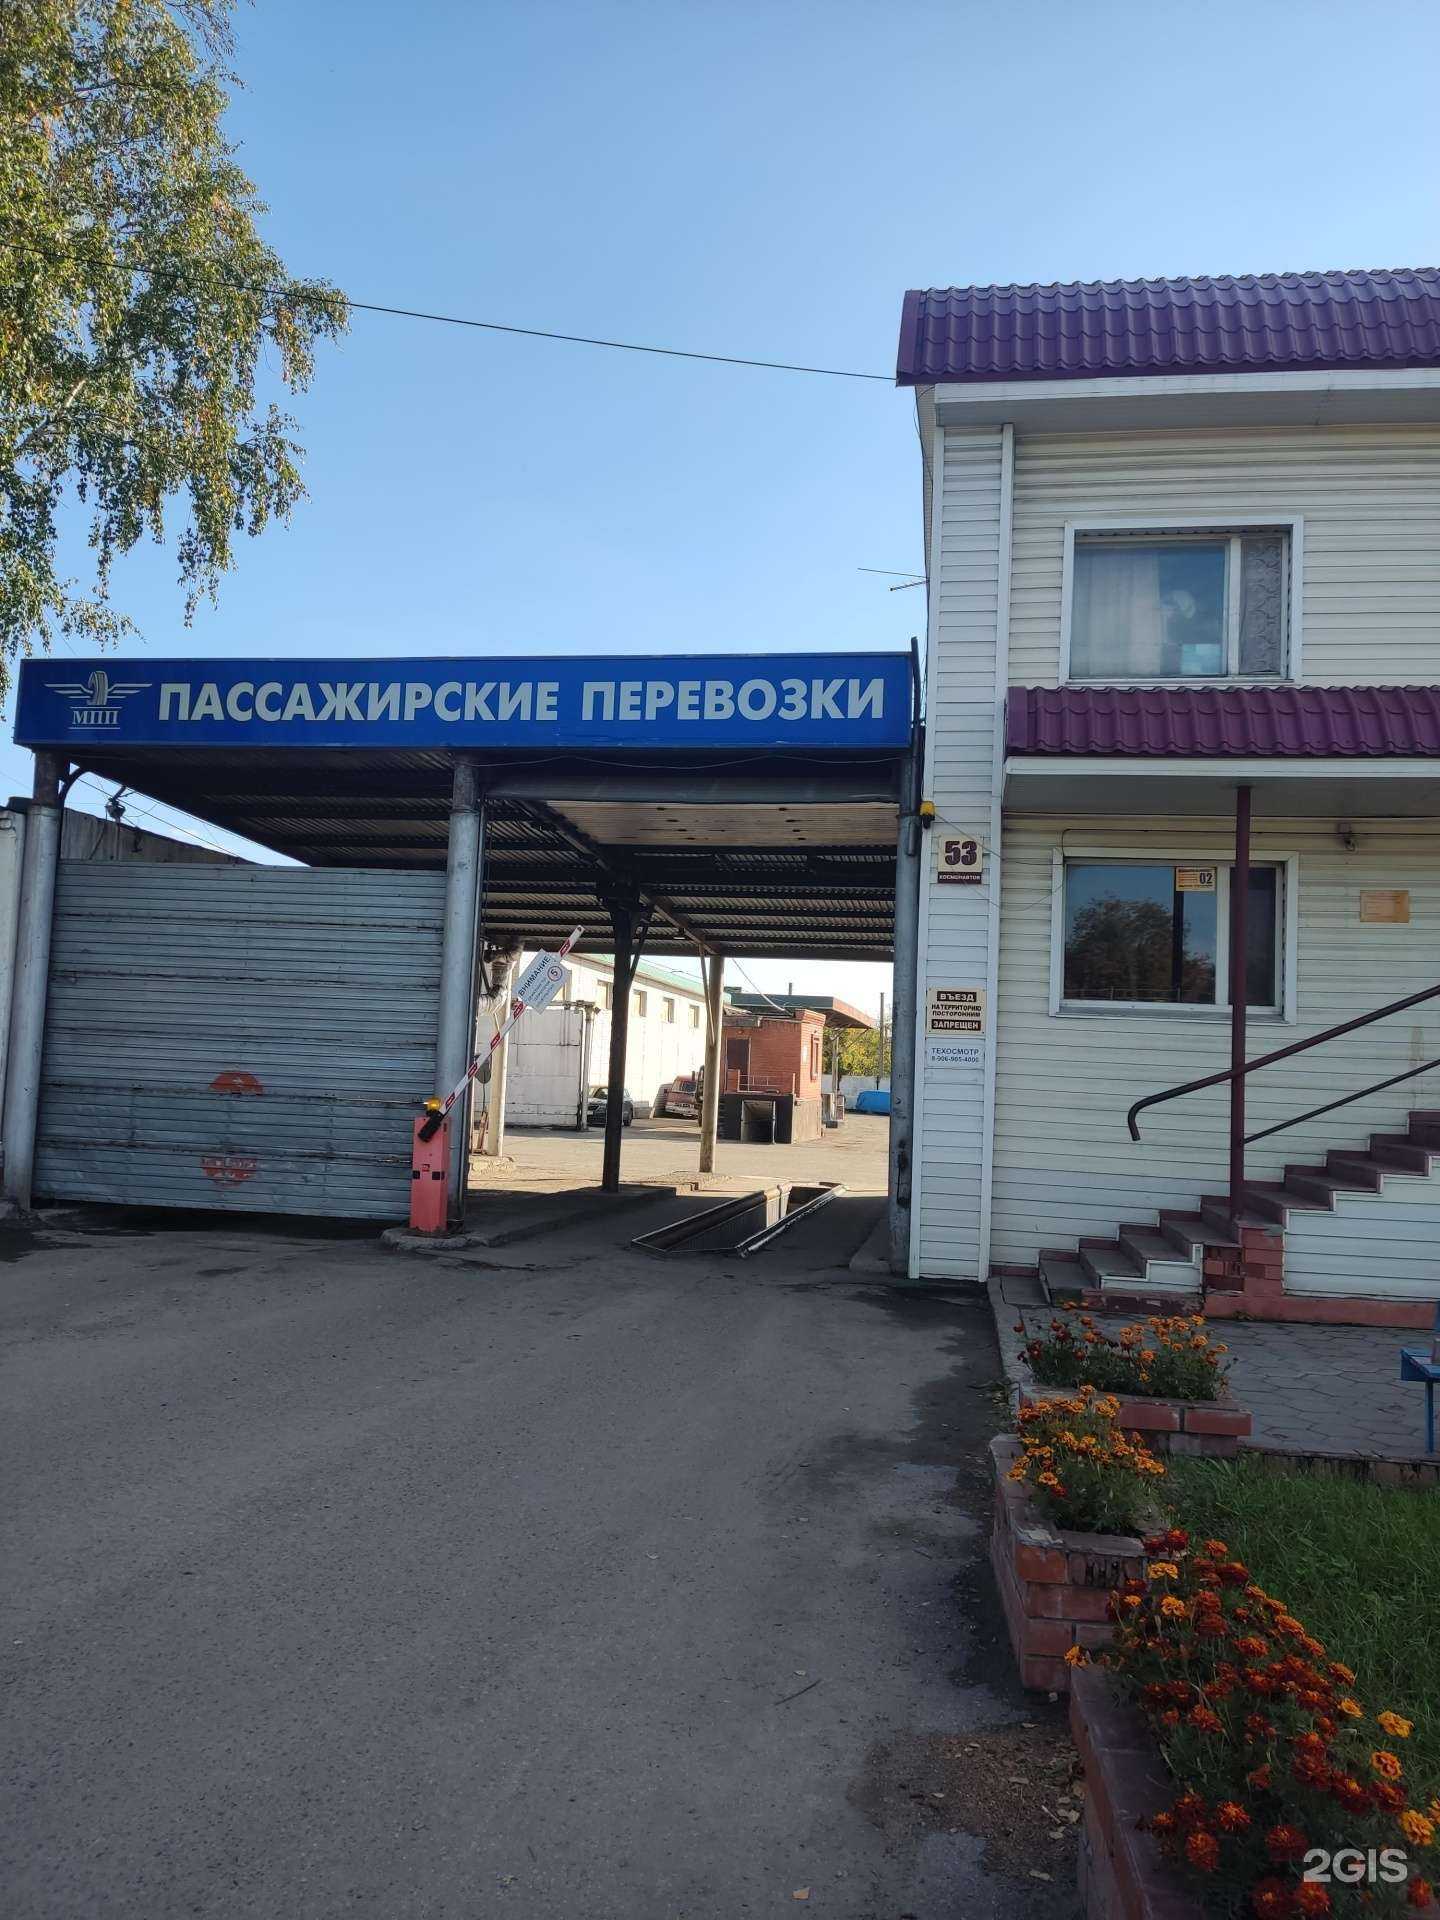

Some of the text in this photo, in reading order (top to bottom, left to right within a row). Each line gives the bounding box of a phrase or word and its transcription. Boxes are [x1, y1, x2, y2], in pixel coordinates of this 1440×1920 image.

[158, 678, 885, 722] ПАССАЖИРСКИЕ ПЕРЕВОЗКИ
[72, 710, 119, 725] МПП
[945, 840, 977, 866] 53
[1200, 872, 1213, 884] 02
[518, 955, 551, 997] ВНИМАНИЕ
[550, 969, 558, 977] 5
[940, 993, 975, 1002] ВЪЕЗД
[933, 1021, 979, 1029] ЗАПРЕЩЕН
[931, 1047, 979, 1056] ТЕХОСМОТР
